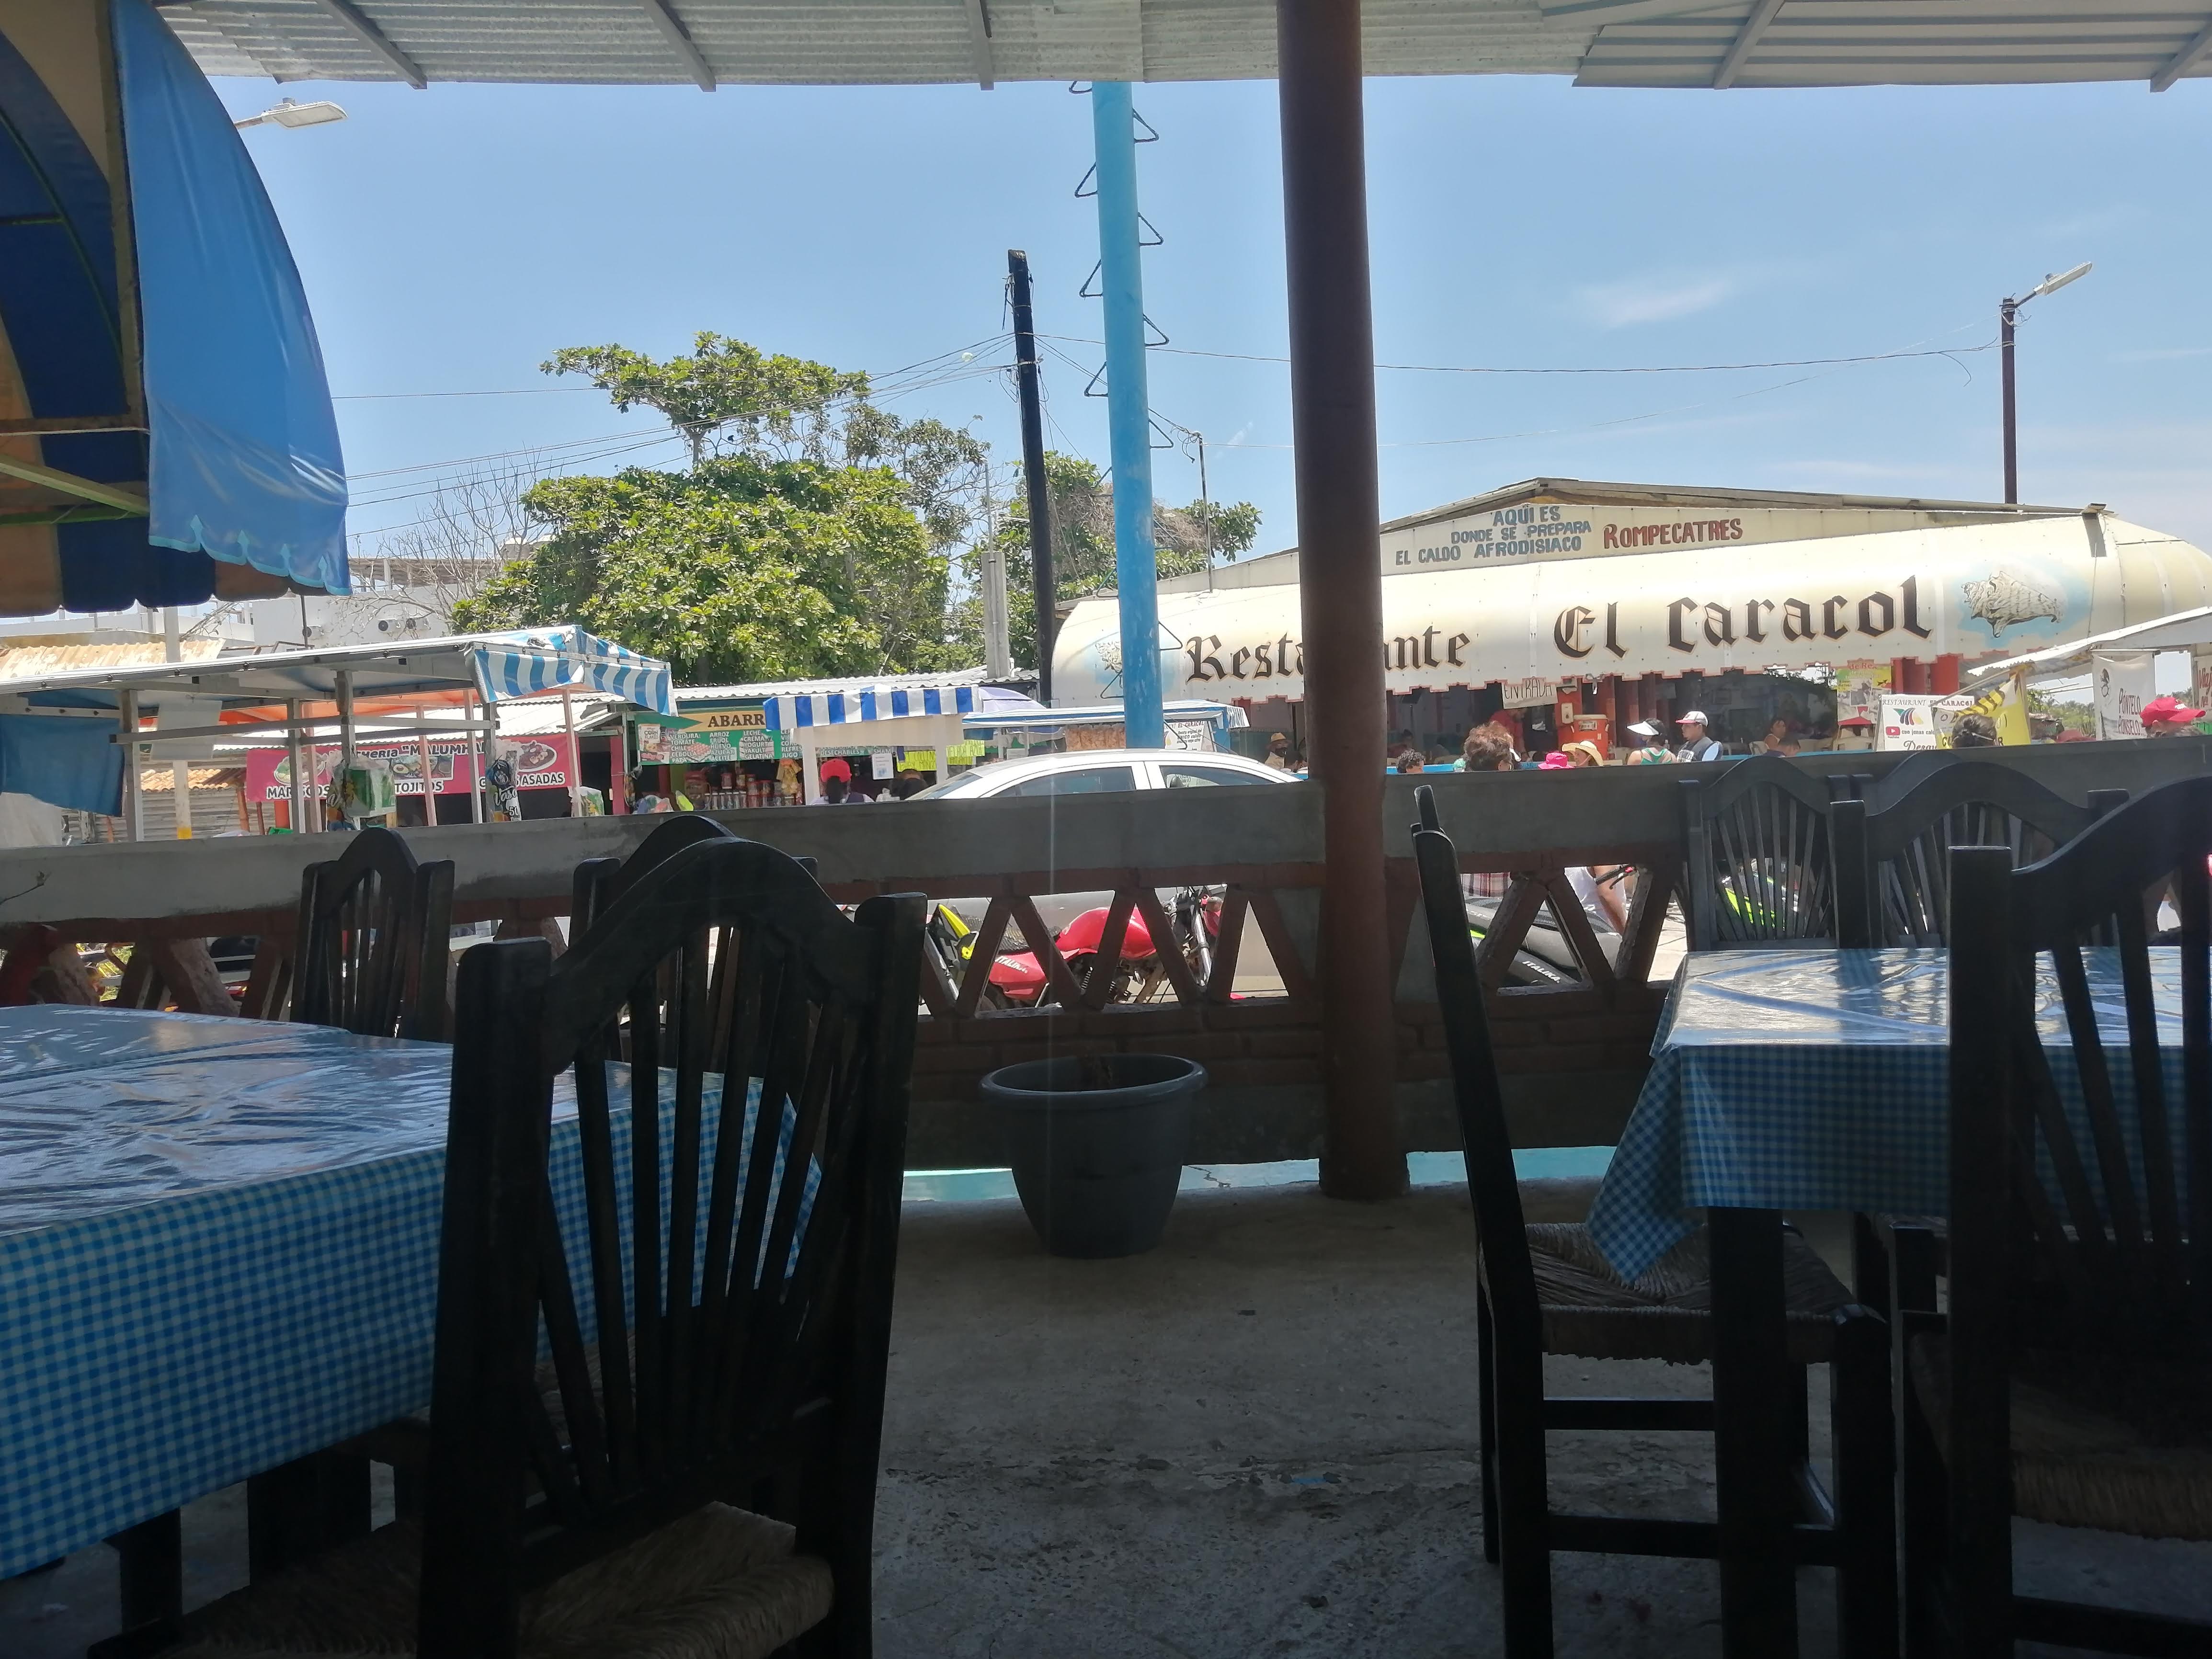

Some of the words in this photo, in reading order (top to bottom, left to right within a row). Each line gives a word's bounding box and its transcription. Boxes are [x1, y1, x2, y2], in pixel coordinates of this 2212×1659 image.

[1539, 506, 1561, 522] ES
[1451, 529, 1493, 544] DONDE
[1501, 527, 1517, 541] SE
[1527, 520, 1592, 538] PREPARA
[1603, 518, 1743, 549] ROMPECATRES
[1395, 550, 1411, 566] EL
[1418, 545, 1461, 564] CALDO
[1474, 536, 1582, 559] AFRODISIACO
[1553, 602, 1628, 659] El
[1666, 575, 1932, 654] Caracol
[522, 773, 564, 785] ASADAS
[1522, 960, 1561, 983] ITALIKA
